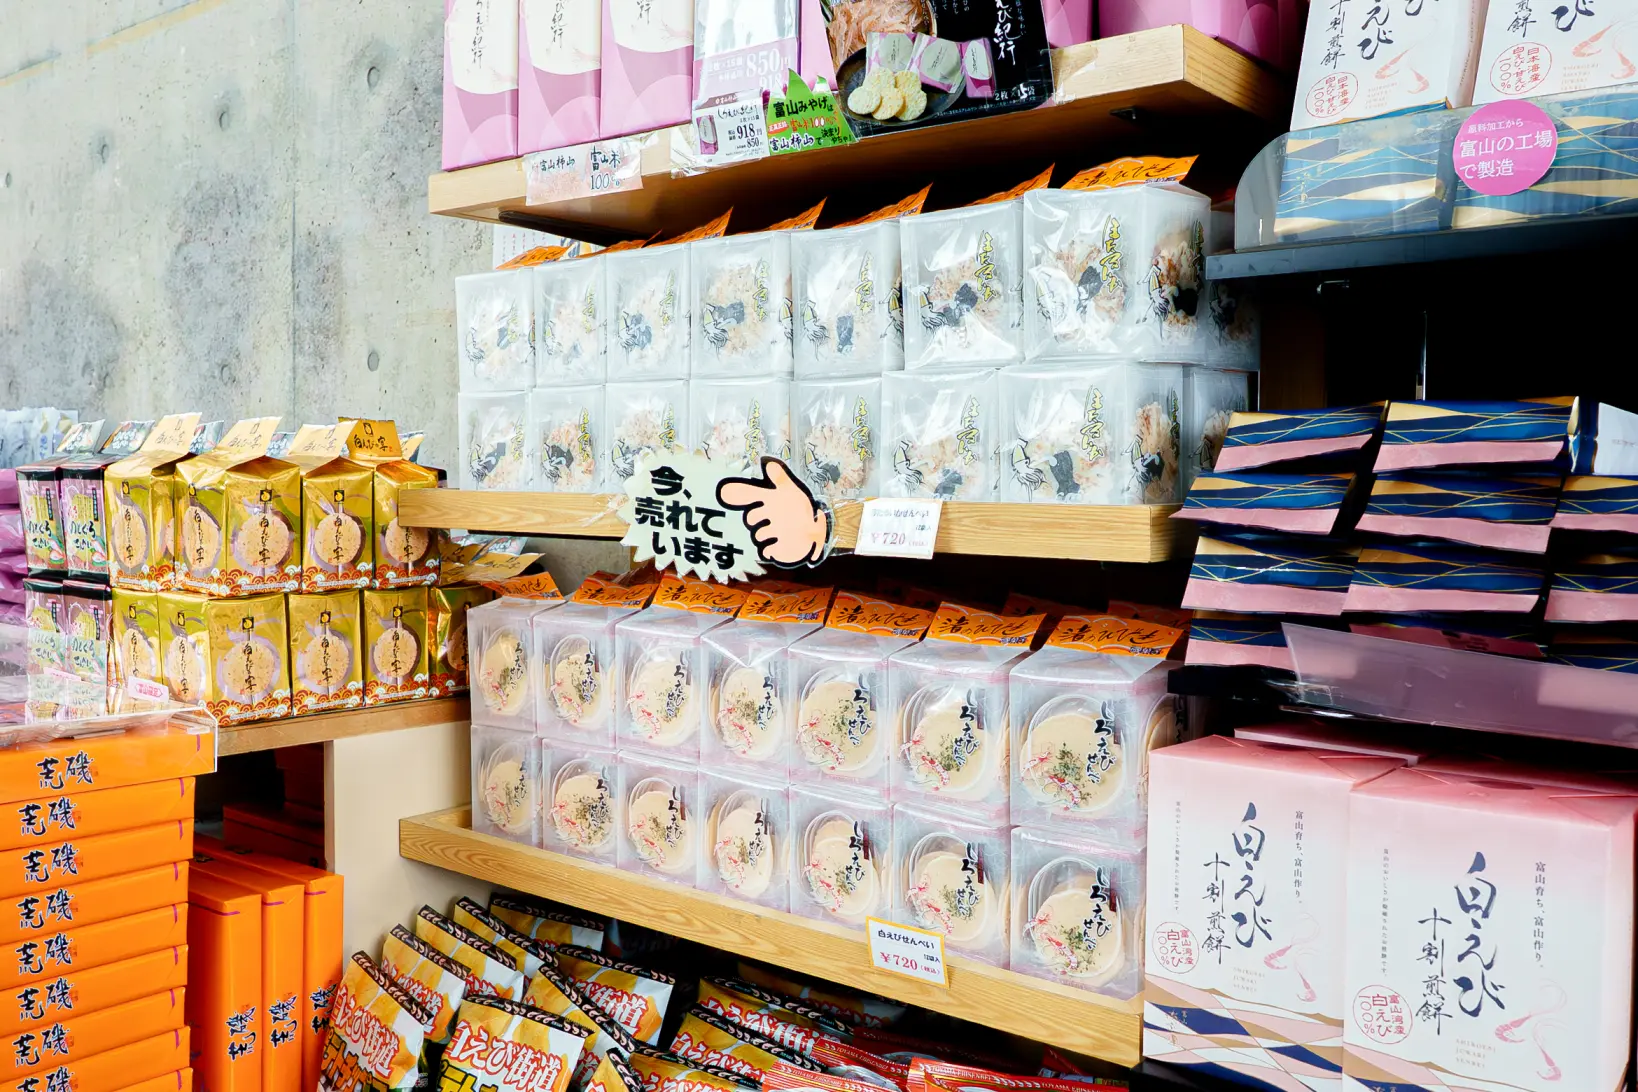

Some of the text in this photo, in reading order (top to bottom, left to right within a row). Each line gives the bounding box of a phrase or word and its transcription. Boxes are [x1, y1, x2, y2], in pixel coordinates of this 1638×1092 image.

[1459, 130, 1553, 158] 富山の工場
[1468, 118, 1524, 134] 原料加工から
[1459, 158, 1514, 179] で製造
[1099, 214, 1124, 293] ほたるいか
[1079, 384, 1107, 461] ほたるいか
[650, 465, 693, 500] 今、
[634, 496, 727, 538] 売れて
[652, 531, 744, 571] います
[853, 673, 871, 736] しろえび
[959, 688, 979, 755] しろえび
[848, 718, 861, 746] せんべい
[1092, 699, 1115, 771] しろえび
[36, 750, 95, 790] 荒磯
[1085, 752, 1100, 783] せんべい
[17, 796, 77, 837] 荒磯
[667, 785, 685, 841] しろえび
[22, 842, 79, 883] 荒磯
[848, 819, 866, 882] しろえび
[1293, 810, 1304, 904] 富山育ち、富山作り。
[960, 841, 980, 907] しろえび
[1231, 801, 1273, 949] 白えび
[17, 888, 75, 930] 荒磯
[1087, 865, 1112, 939] しろえび
[1201, 852, 1231, 965] 十割煎餅
[1533, 861, 1546, 968] 富山育ち、富山作り。
[15, 932, 74, 976] 荒磯
[877, 929, 935, 950] 白えびせんべい
[1082, 917, 1096, 951] せんべい
[1167, 928, 1184, 967] 白えび
[1452, 851, 1506, 1018] 白えび
[879, 951, 918, 971] ¥720
[1415, 907, 1453, 1036] 十割煎餅
[16, 976, 75, 1022] 荒磯
[268, 994, 298, 1049] 荒磯
[1372, 993, 1393, 1037] 白えび
[12, 1022, 71, 1068] 荒磯
[225, 1005, 258, 1062] 荒磯
